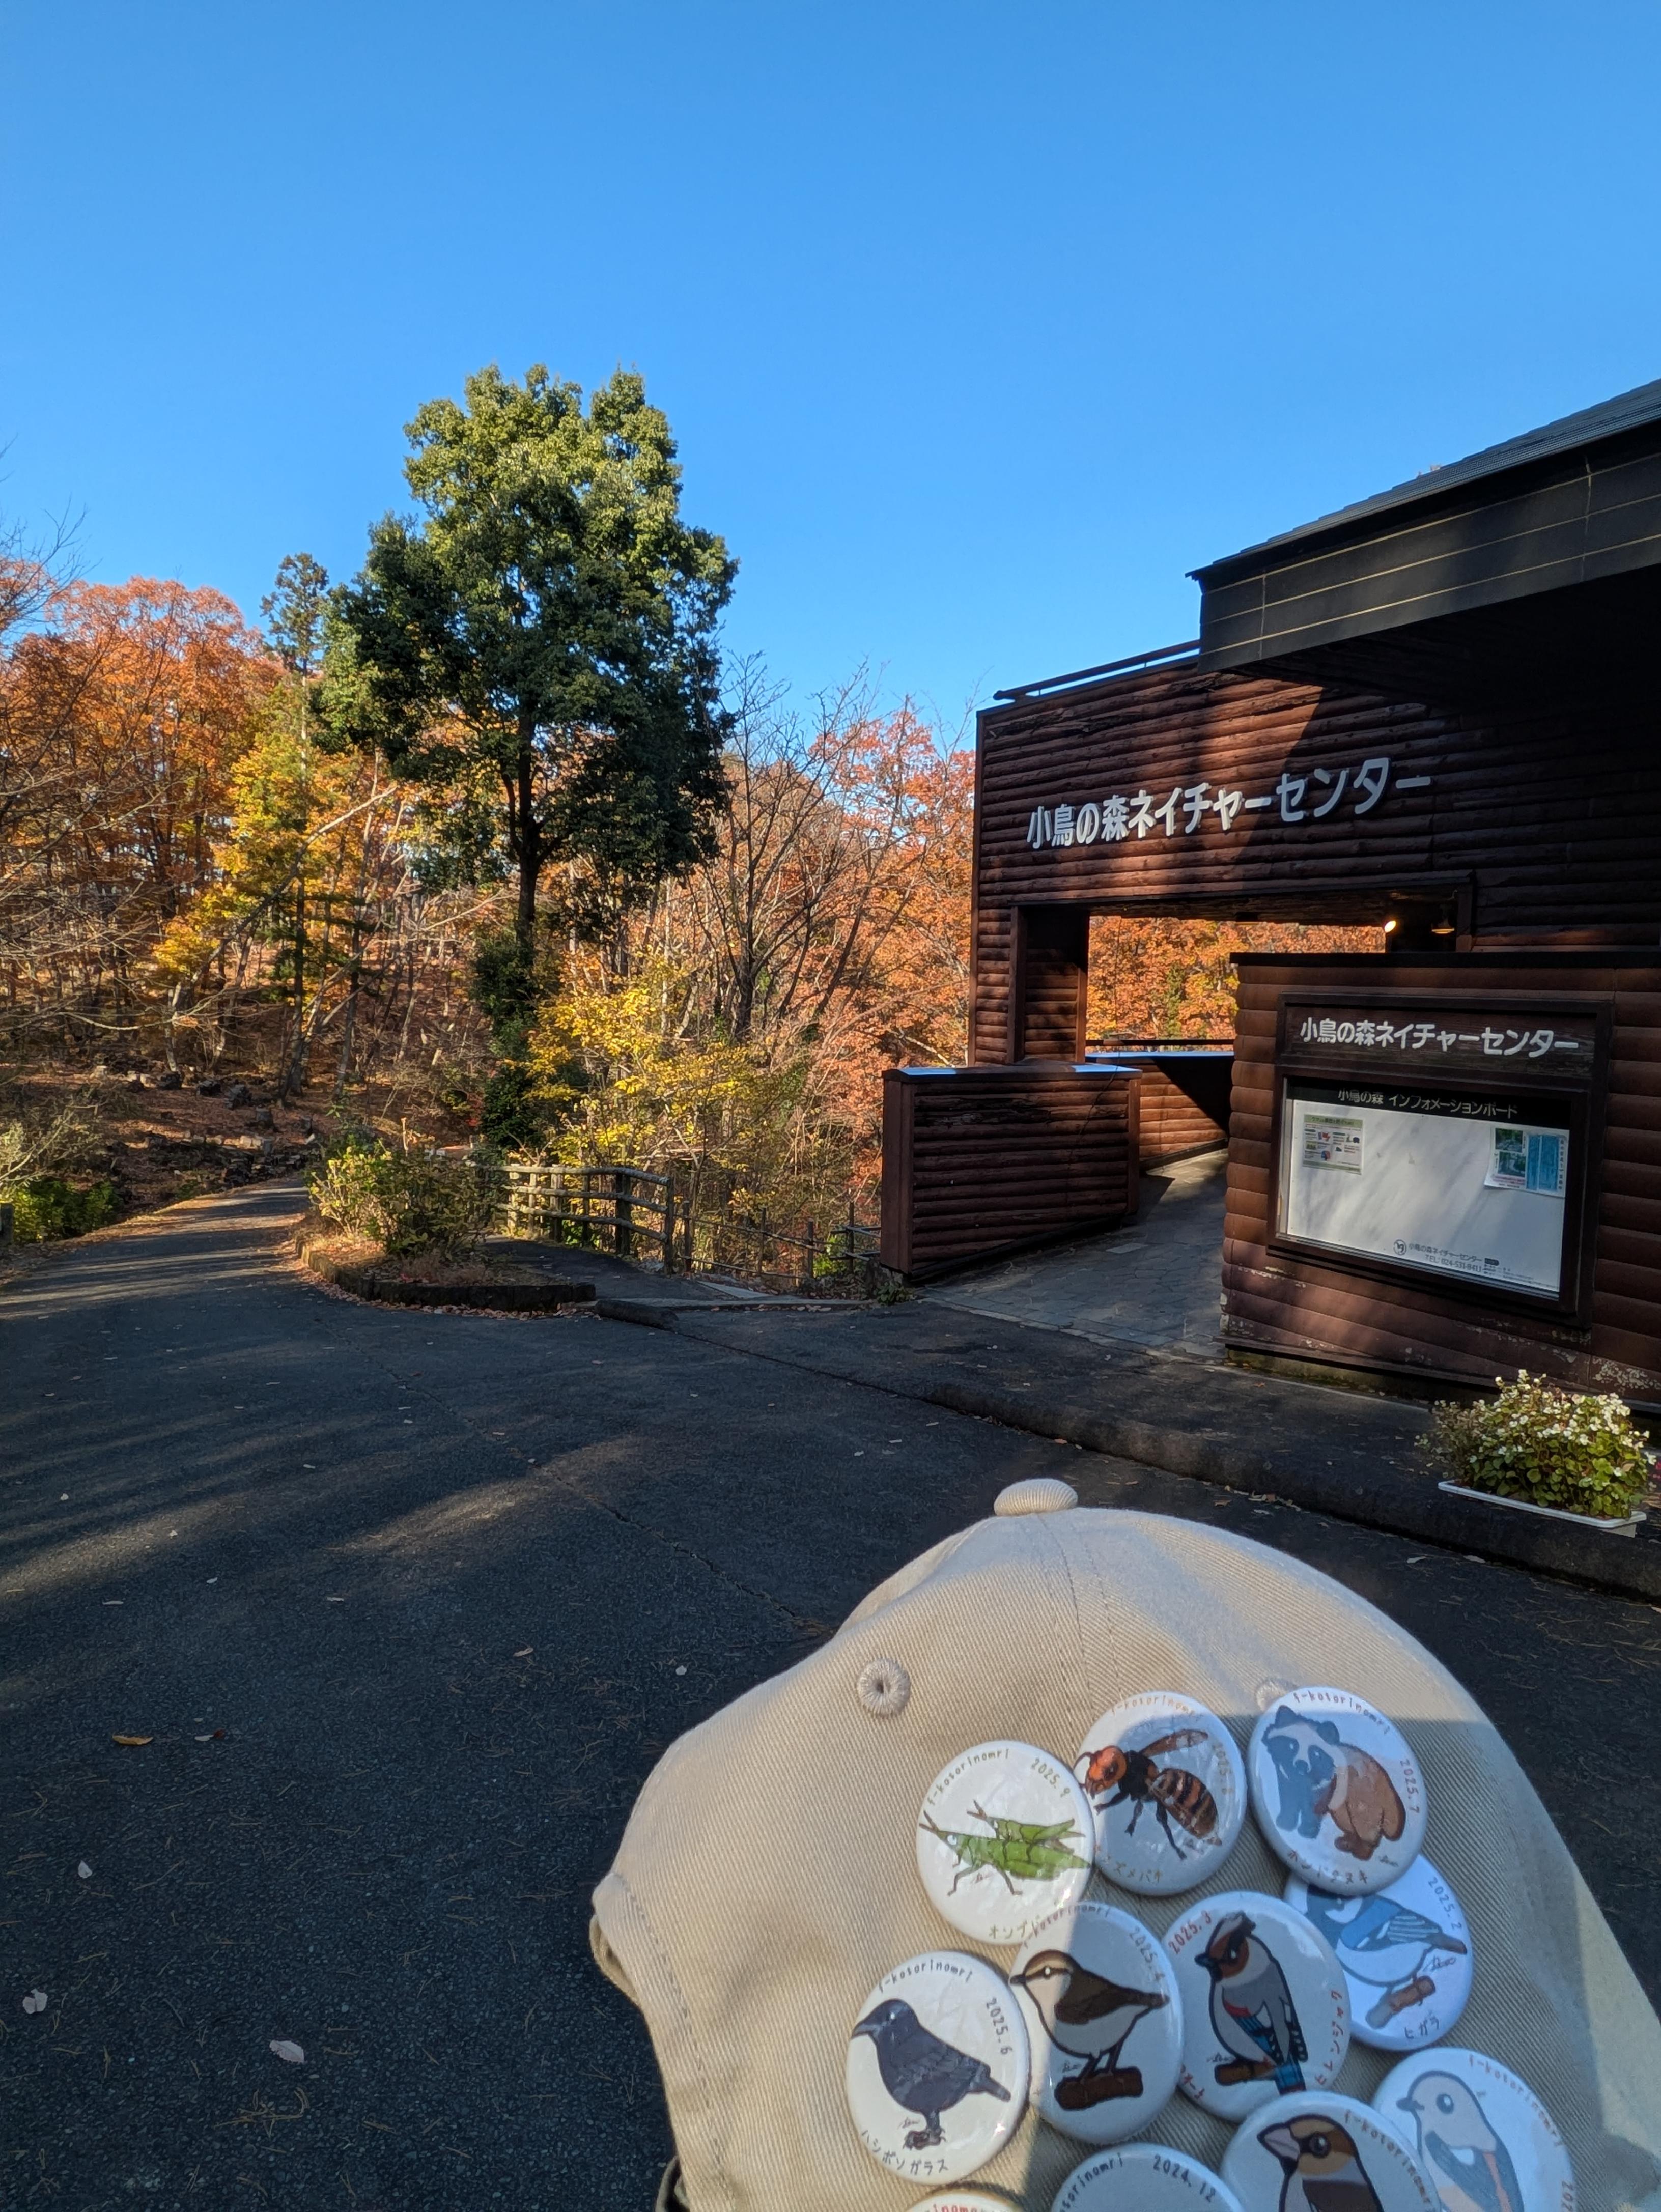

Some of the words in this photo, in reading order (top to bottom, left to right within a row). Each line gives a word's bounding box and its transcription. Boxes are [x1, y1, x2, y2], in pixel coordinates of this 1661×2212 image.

[1027, 757, 1432, 849] 小鳥の森ネイチャーセンター
[1300, 1017, 1579, 1058] 小鳥の森ネイチャーセンター
[1338, 1089, 1384, 1105] 小鳥の森
[1389, 1094, 1517, 1119] インフォメーションボード
[927, 1748, 1009, 1806] f-kotorinomri
[879, 1959, 973, 1993] f-kotorinomri
[861, 2130, 949, 2176] ハシボソガラス
[1060, 2152, 1123, 2212] torinomri
